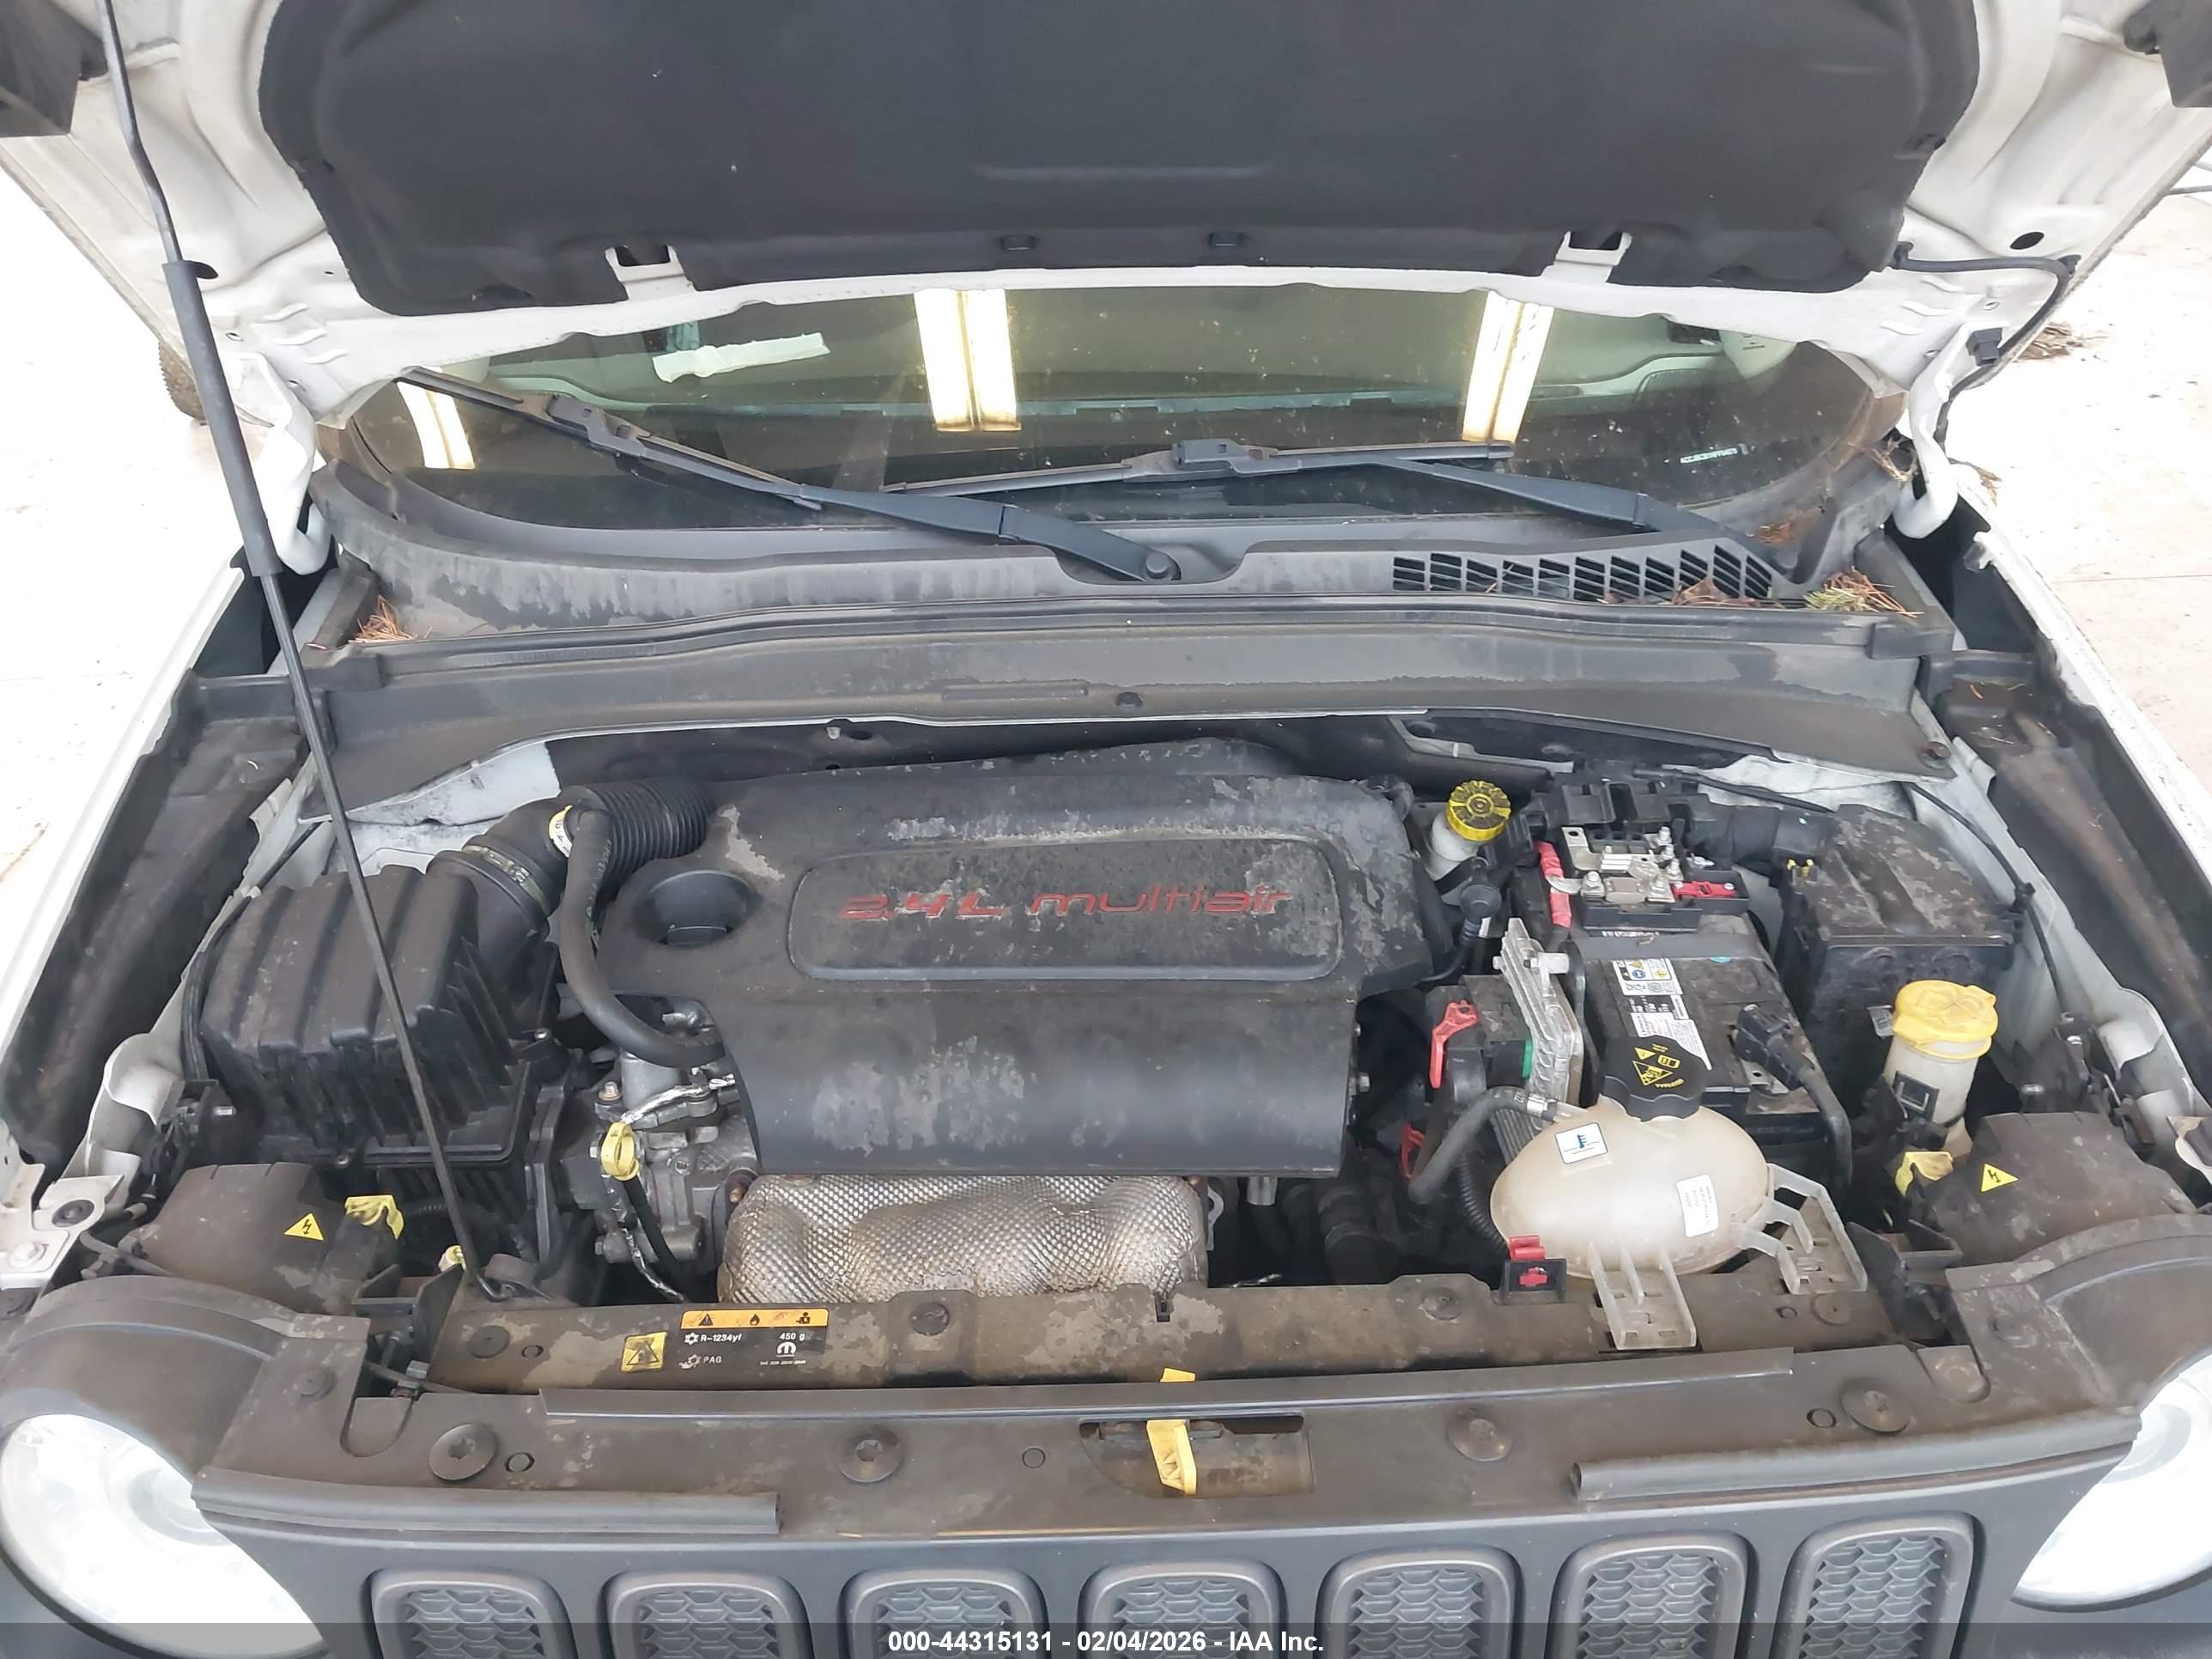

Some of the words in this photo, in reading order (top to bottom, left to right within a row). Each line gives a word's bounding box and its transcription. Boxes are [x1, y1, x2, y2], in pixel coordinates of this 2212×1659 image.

[838, 892, 1005, 920] 2.4L
[1029, 883, 1291, 915] multiair
[701, 1333, 743, 1344] R-1234yf
[780, 1332, 797, 1340] 450
[799, 1333, 805, 1341] g
